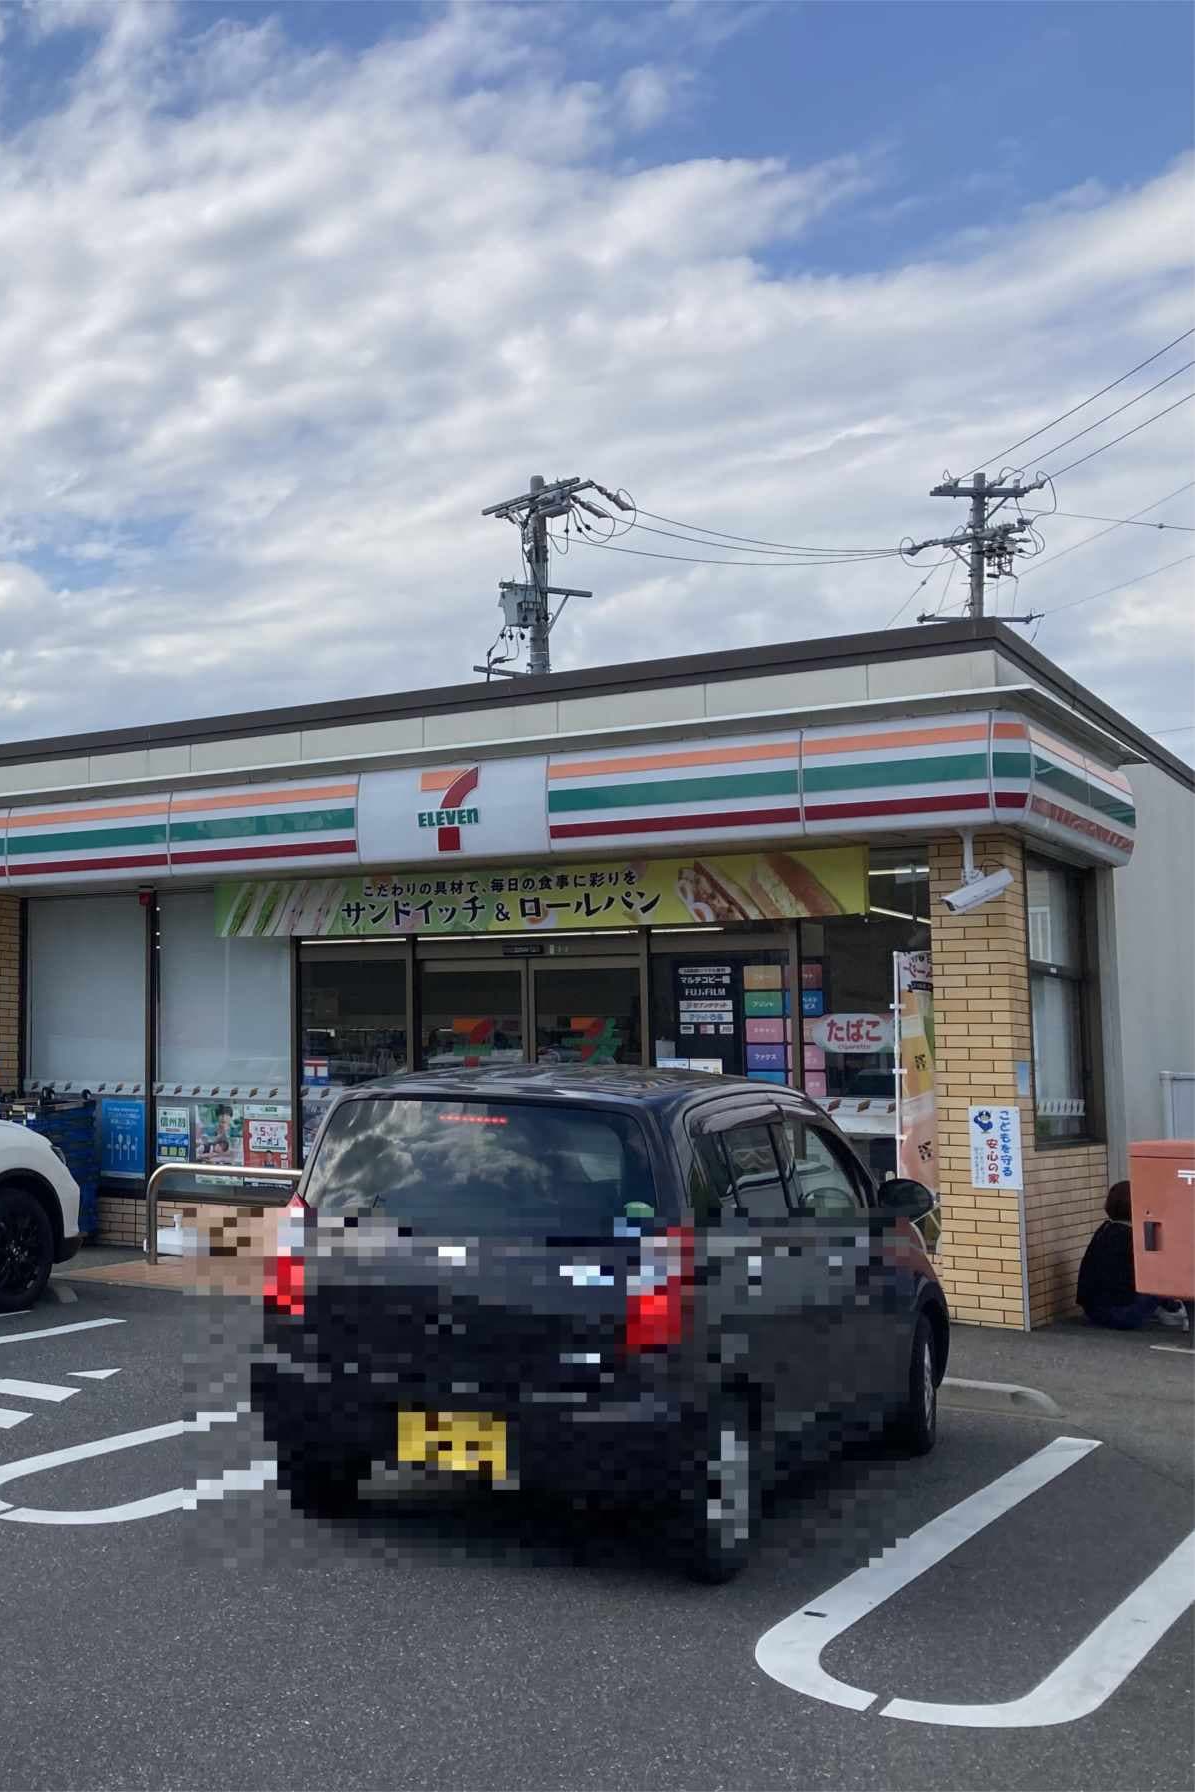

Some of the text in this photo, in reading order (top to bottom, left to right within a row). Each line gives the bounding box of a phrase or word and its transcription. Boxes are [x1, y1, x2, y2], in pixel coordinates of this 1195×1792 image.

[363, 870, 636, 898] こだわりの具材で、毎日の食事に彩りを
[341, 890, 661, 927] サンドイッチ & ロールパン
[826, 1018, 883, 1042] たばこ
[986, 1138, 1000, 1184] 安心の家
[1000, 1110, 1013, 1177] こどもを守る
